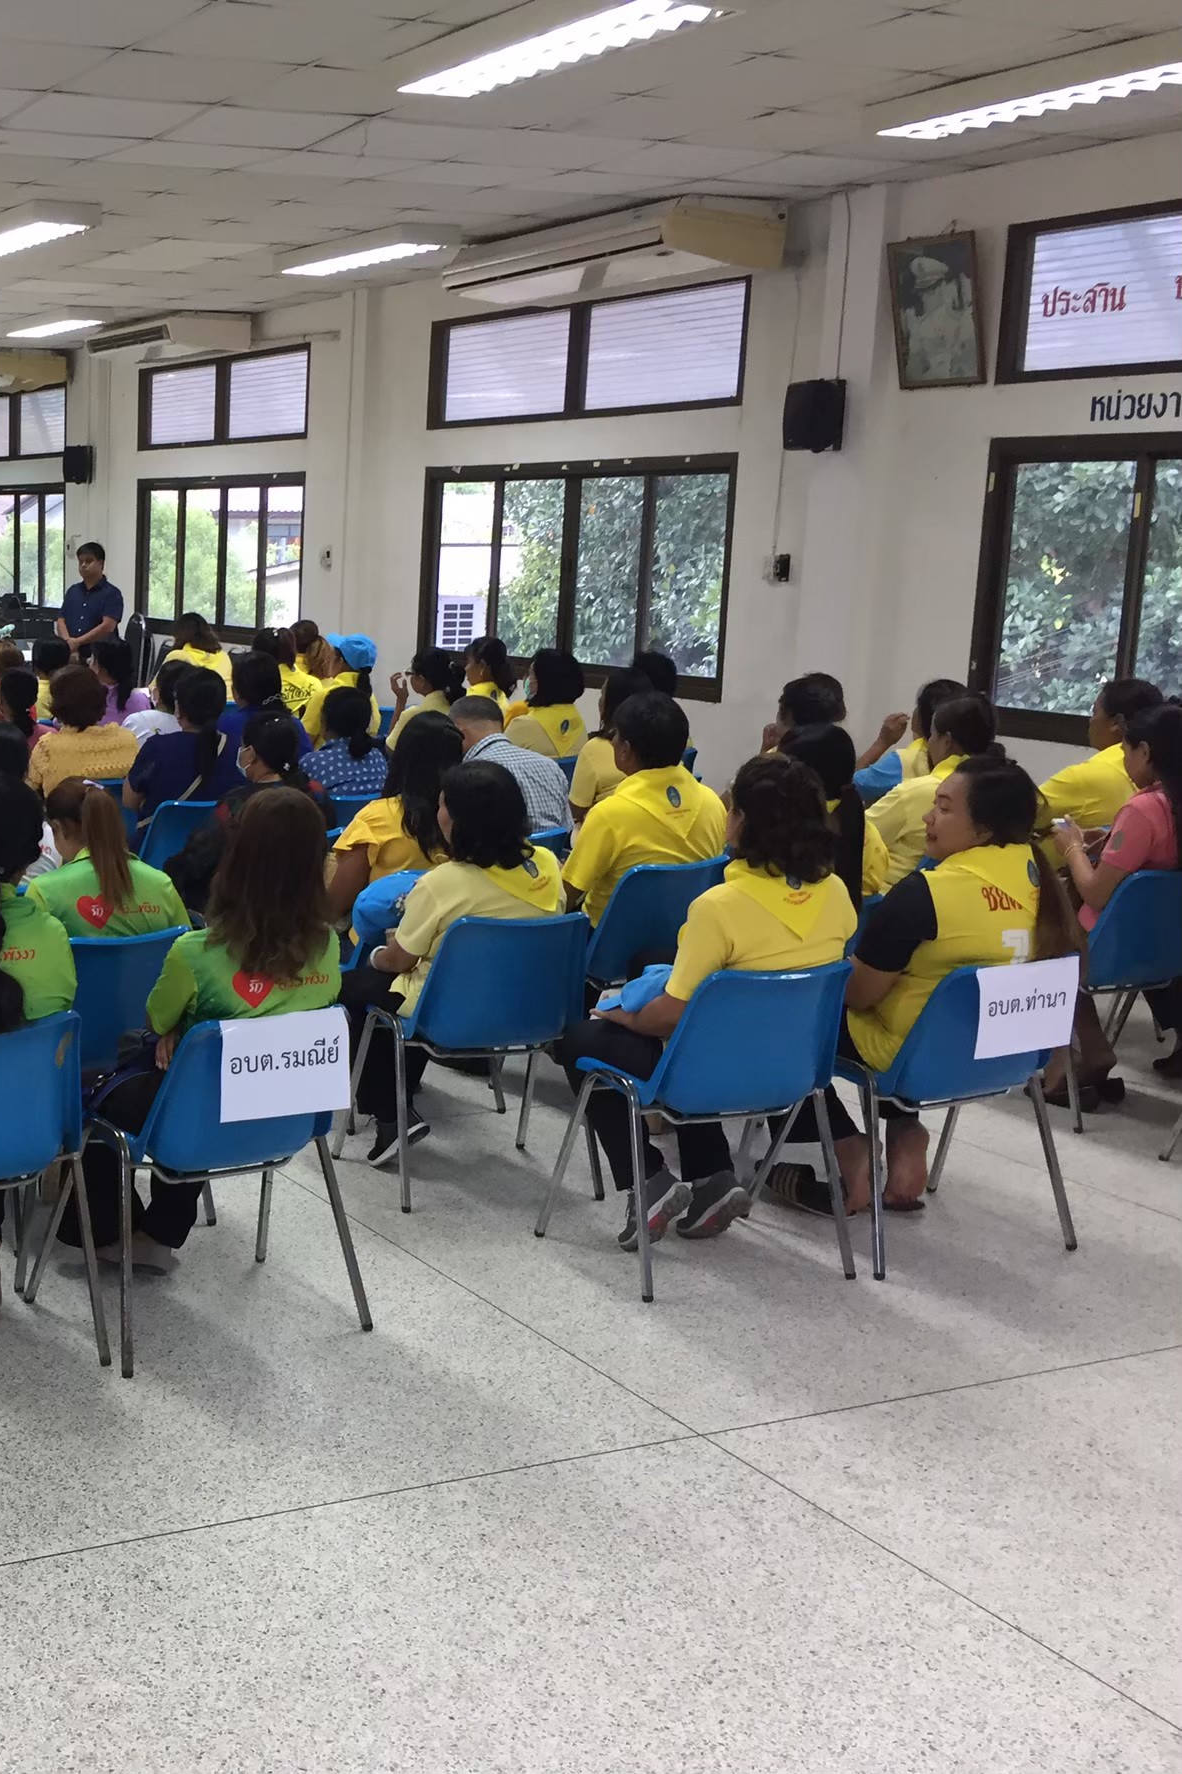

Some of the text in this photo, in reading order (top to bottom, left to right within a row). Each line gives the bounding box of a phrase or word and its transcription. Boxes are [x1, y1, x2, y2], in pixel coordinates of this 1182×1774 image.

[1041, 282, 1127, 317] ประสาน
[988, 988, 1067, 1018] อบต.ท่านา
[229, 1035, 340, 1075] อบต.รมณีย์
